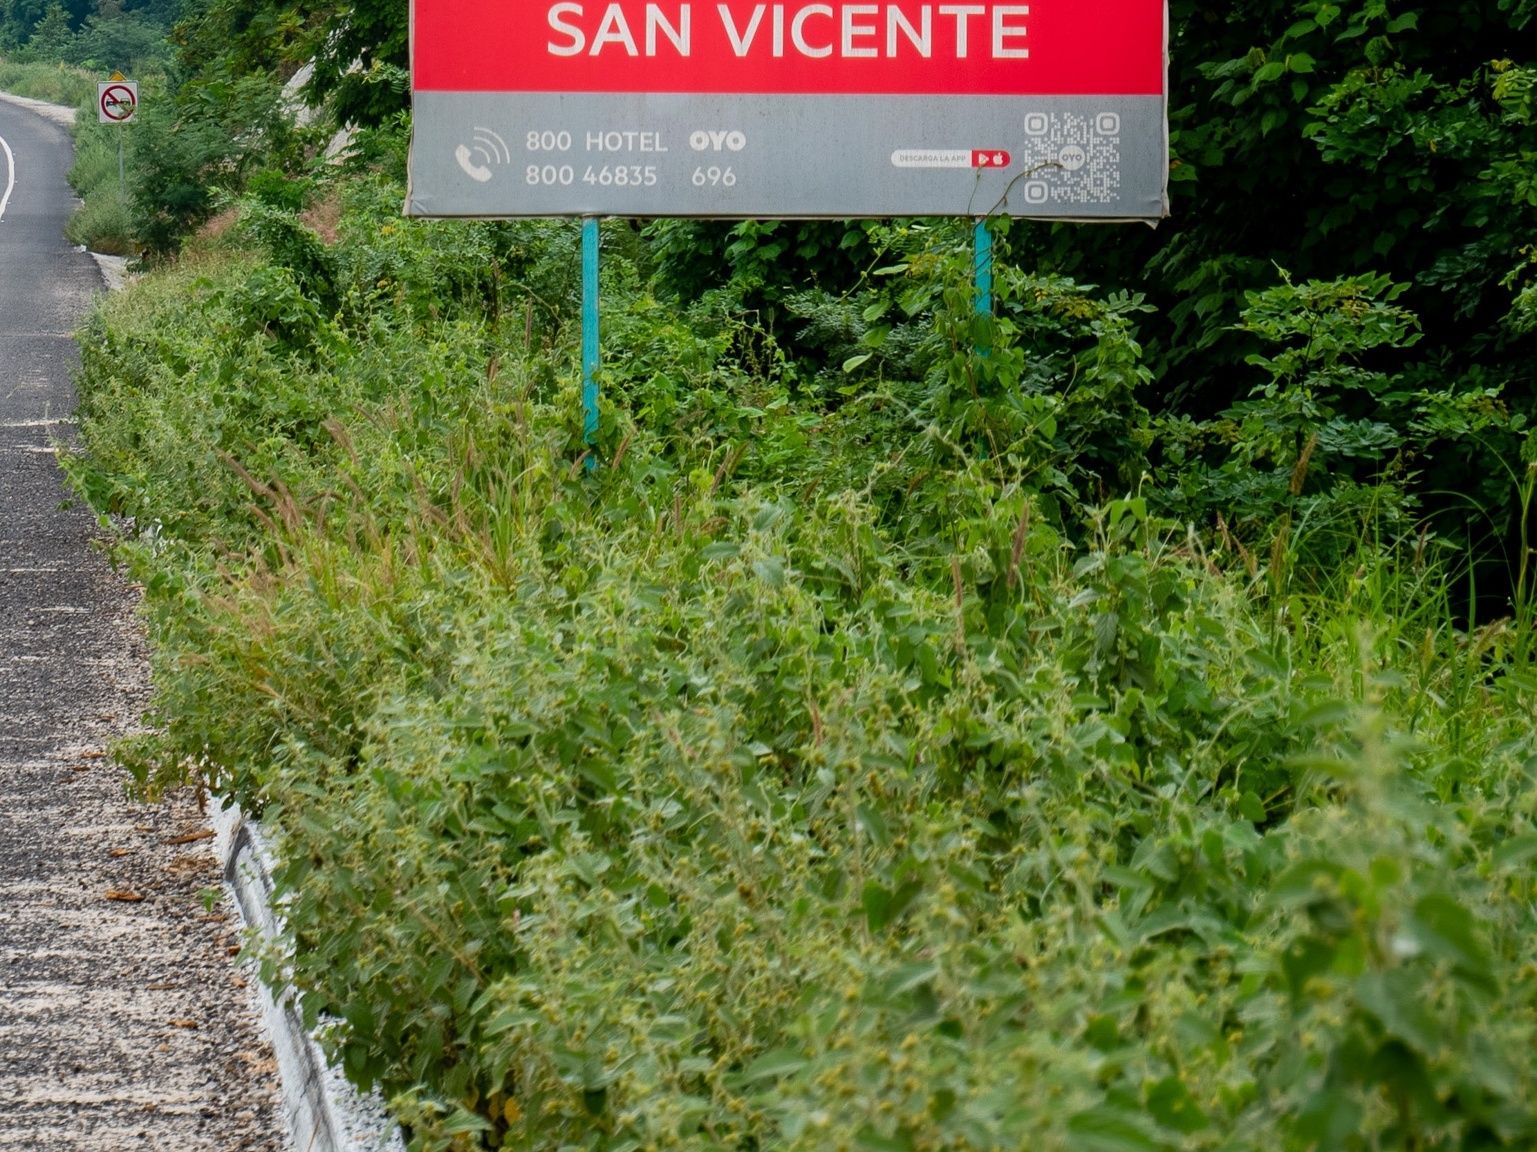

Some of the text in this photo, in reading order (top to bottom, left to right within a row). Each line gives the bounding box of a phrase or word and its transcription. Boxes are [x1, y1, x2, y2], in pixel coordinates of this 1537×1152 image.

[546, 2, 1031, 59] SAN VICENTE
[526, 129, 747, 152] 800 HOTEL OYO
[899, 154, 966, 162] DESCARGA LA APP
[1062, 153, 1082, 162] OYO
[525, 164, 738, 187] 800 46835 696
